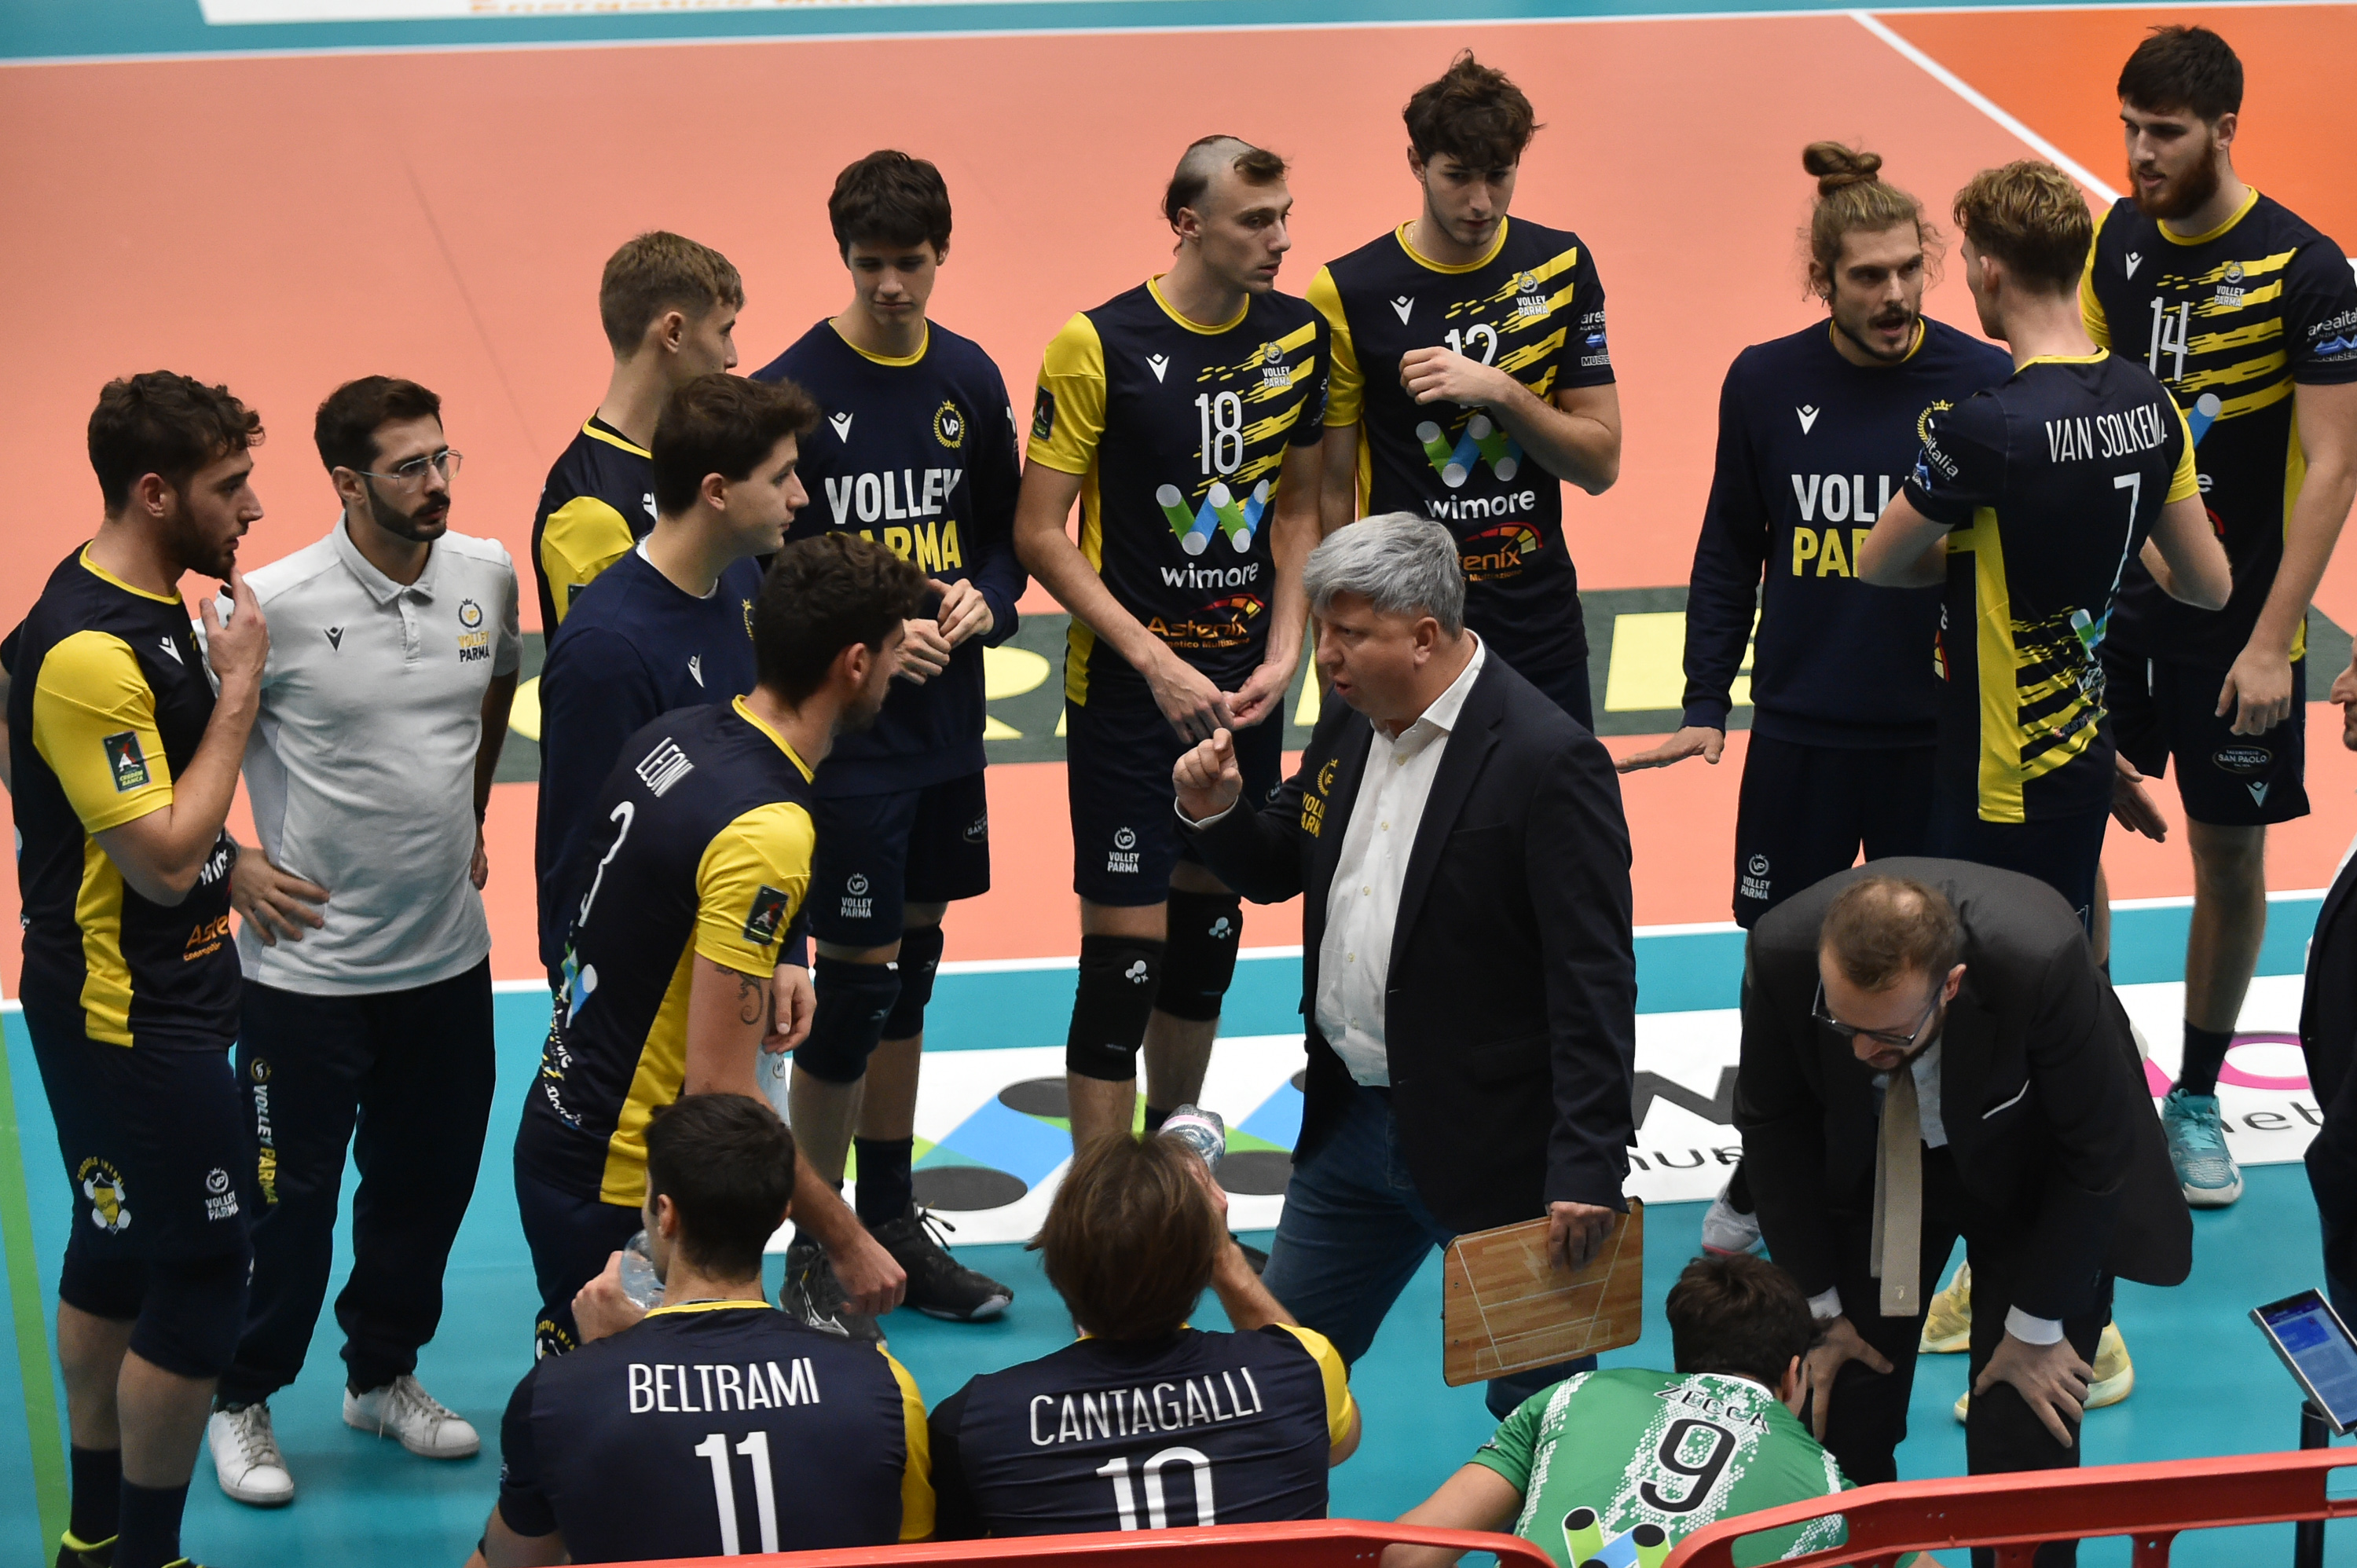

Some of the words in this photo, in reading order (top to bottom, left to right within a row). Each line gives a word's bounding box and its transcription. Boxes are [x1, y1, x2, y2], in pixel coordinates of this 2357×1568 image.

[1516, 295, 1545, 306] VOLLEY
[2214, 295, 2242, 306] PARMA
[2216, 284, 2245, 296] VOLLEY
[1518, 306, 1549, 316] PARMA
[2149, 296, 2189, 382] 14
[1263, 366, 1290, 377] VOLLEY
[1264, 377, 1292, 387] PARMA
[1195, 391, 1243, 474] 18
[2046, 417, 2093, 463] VAN
[825, 469, 962, 524] VOLLEY
[1424, 490, 1535, 519] wimore
[1791, 474, 1890, 522] VOLL
[2113, 472, 2140, 589] 7
[826, 520, 962, 574] RMA
[1160, 562, 1259, 588] wimore
[457, 631, 489, 649] VOLLEY
[460, 645, 490, 662] PARMA
[2218, 753, 2236, 762] SAN
[2238, 755, 2267, 764] PAOLO
[1108, 862, 1138, 874] PARMA
[1109, 852, 1139, 863] VOLLEY
[1740, 885, 1768, 899] PARMA
[1743, 874, 1770, 889] VOLLEY
[841, 897, 872, 907] VOLLEY
[841, 907, 871, 918] PARMA
[185, 914, 229, 948] Aste
[254, 1085, 273, 1147] VOLLEY
[258, 1147, 278, 1204] PARMA
[208, 1202, 239, 1220] PARMA
[629, 1357, 820, 1413] BELTRAMI
[1030, 1367, 1263, 1445] CANTAGALLI
[1653, 1382, 1770, 1434] ZECCA
[1640, 1419, 1736, 1513] 9
[695, 1431, 779, 1555] 11
[1095, 1446, 1215, 1531] 10
